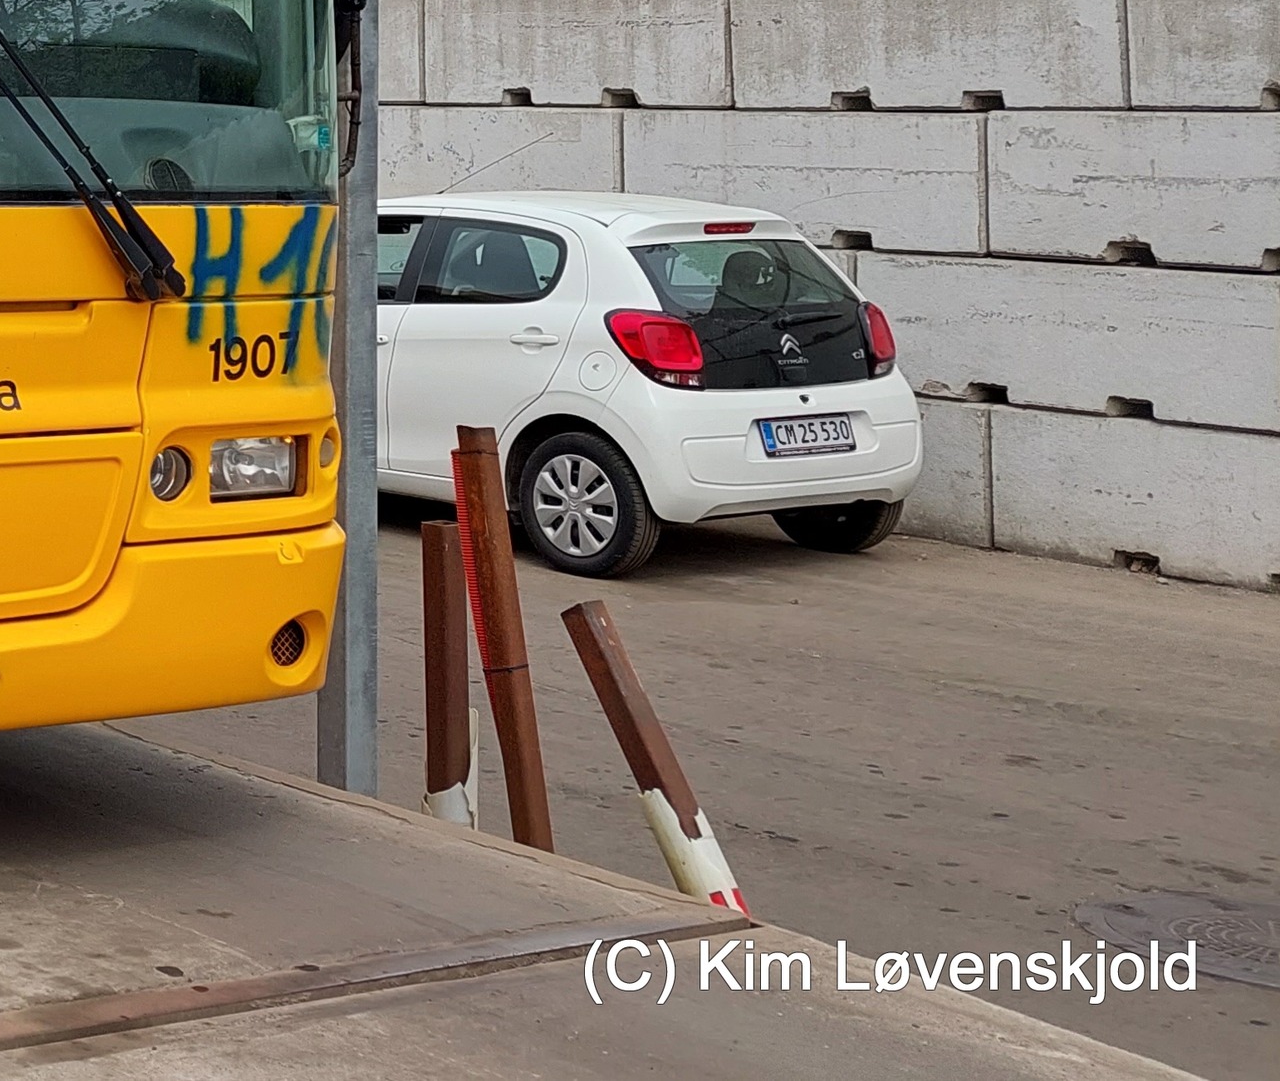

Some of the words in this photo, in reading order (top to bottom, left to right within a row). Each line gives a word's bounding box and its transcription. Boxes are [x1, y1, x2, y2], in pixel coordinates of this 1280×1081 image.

[209, 330, 300, 382] 1907
[775, 424, 798, 445] CM
[798, 422, 819, 444] 25
[820, 420, 850, 441] 530
